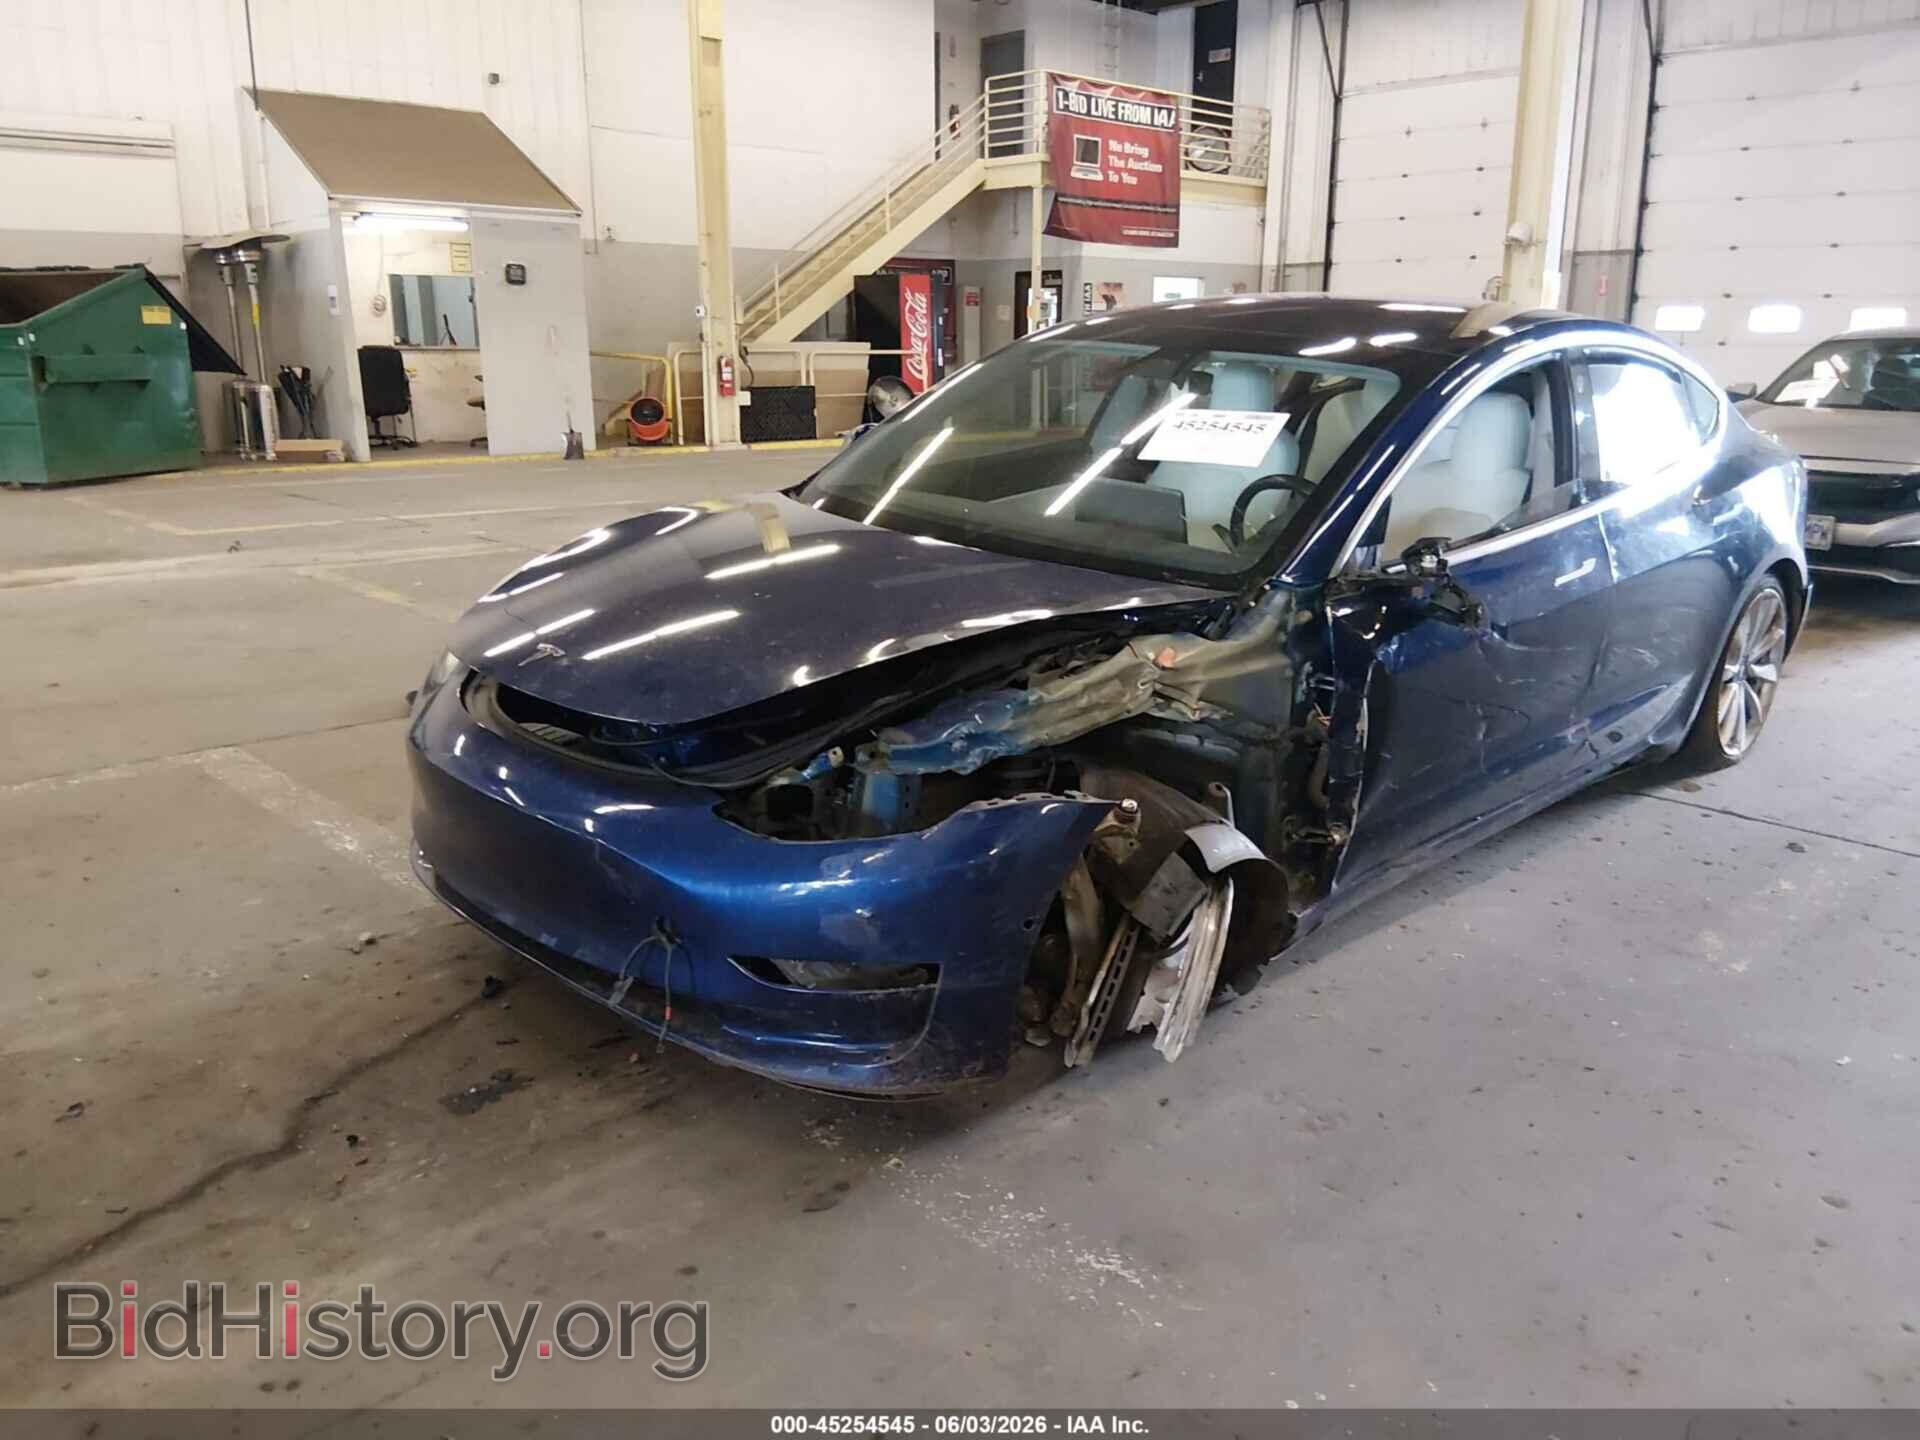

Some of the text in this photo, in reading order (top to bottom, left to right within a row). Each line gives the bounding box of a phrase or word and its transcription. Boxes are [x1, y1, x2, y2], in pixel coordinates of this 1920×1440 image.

[1091, 97, 1116, 120] LIVE
[1118, 101, 1151, 125] FROM
[1123, 142, 1149, 158] Bring
[1108, 155, 1163, 173] The Auction
[1108, 170, 1138, 185] To You
